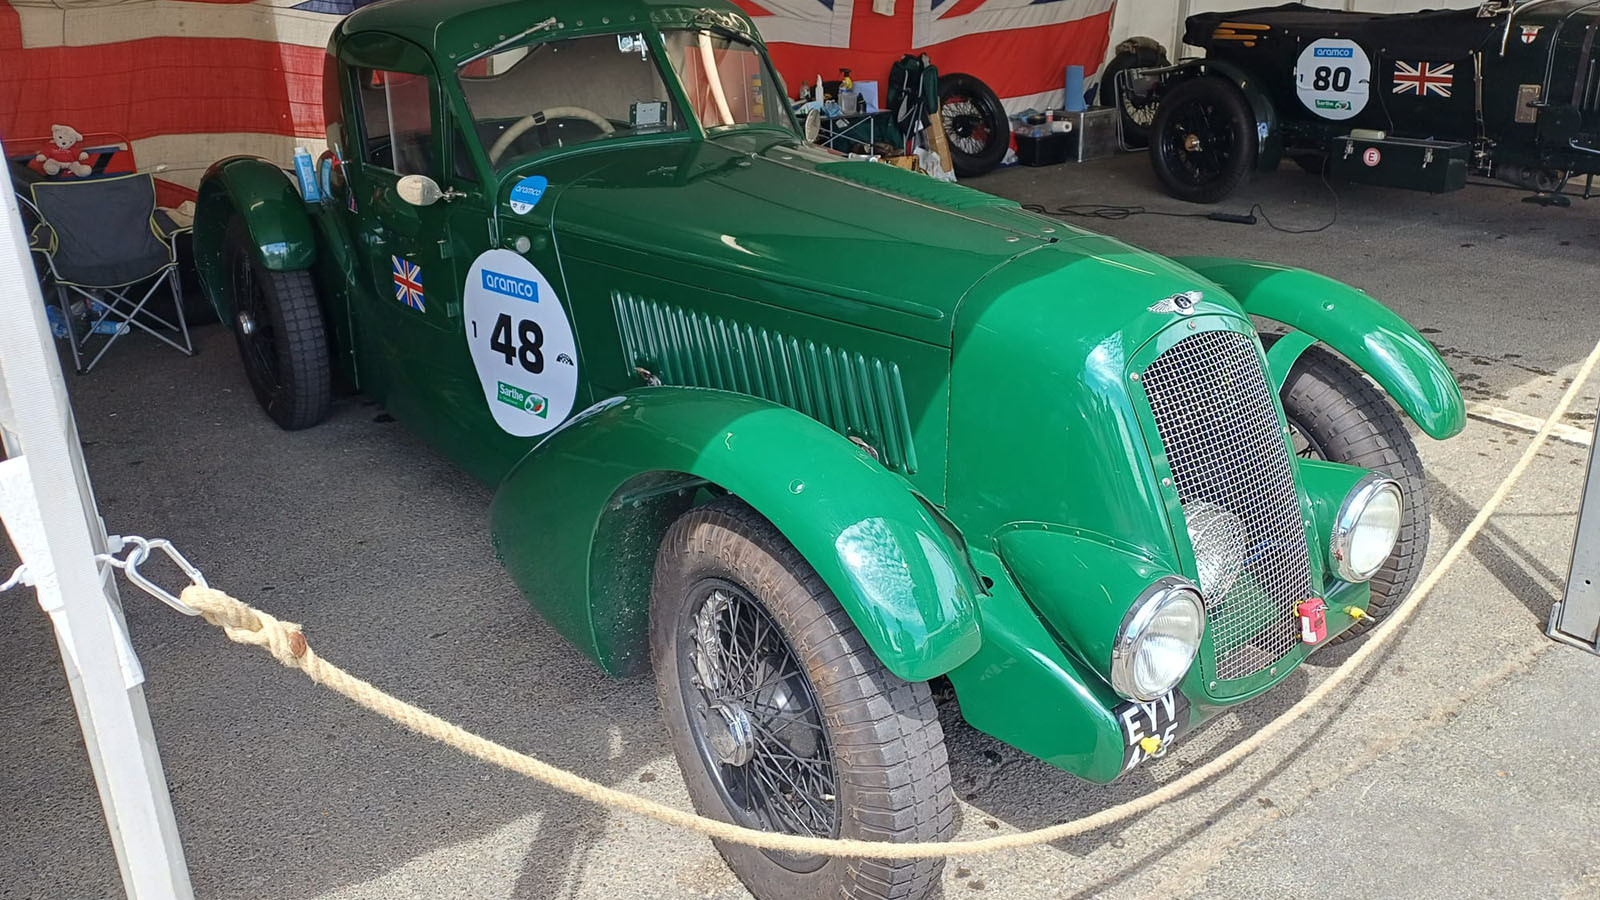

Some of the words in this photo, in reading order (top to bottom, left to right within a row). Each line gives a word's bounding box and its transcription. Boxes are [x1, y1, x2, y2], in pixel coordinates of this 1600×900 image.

[1317, 49, 1350, 57] aramco
[1300, 74, 1304, 82] 1
[1313, 66, 1352, 92] 80
[515, 186, 541, 196] aramco
[486, 275, 533, 297] aramco
[472, 321, 478, 338] 1
[490, 313, 544, 374] 48
[500, 384, 524, 402] Sarthe
[1121, 689, 1176, 746] EYV
